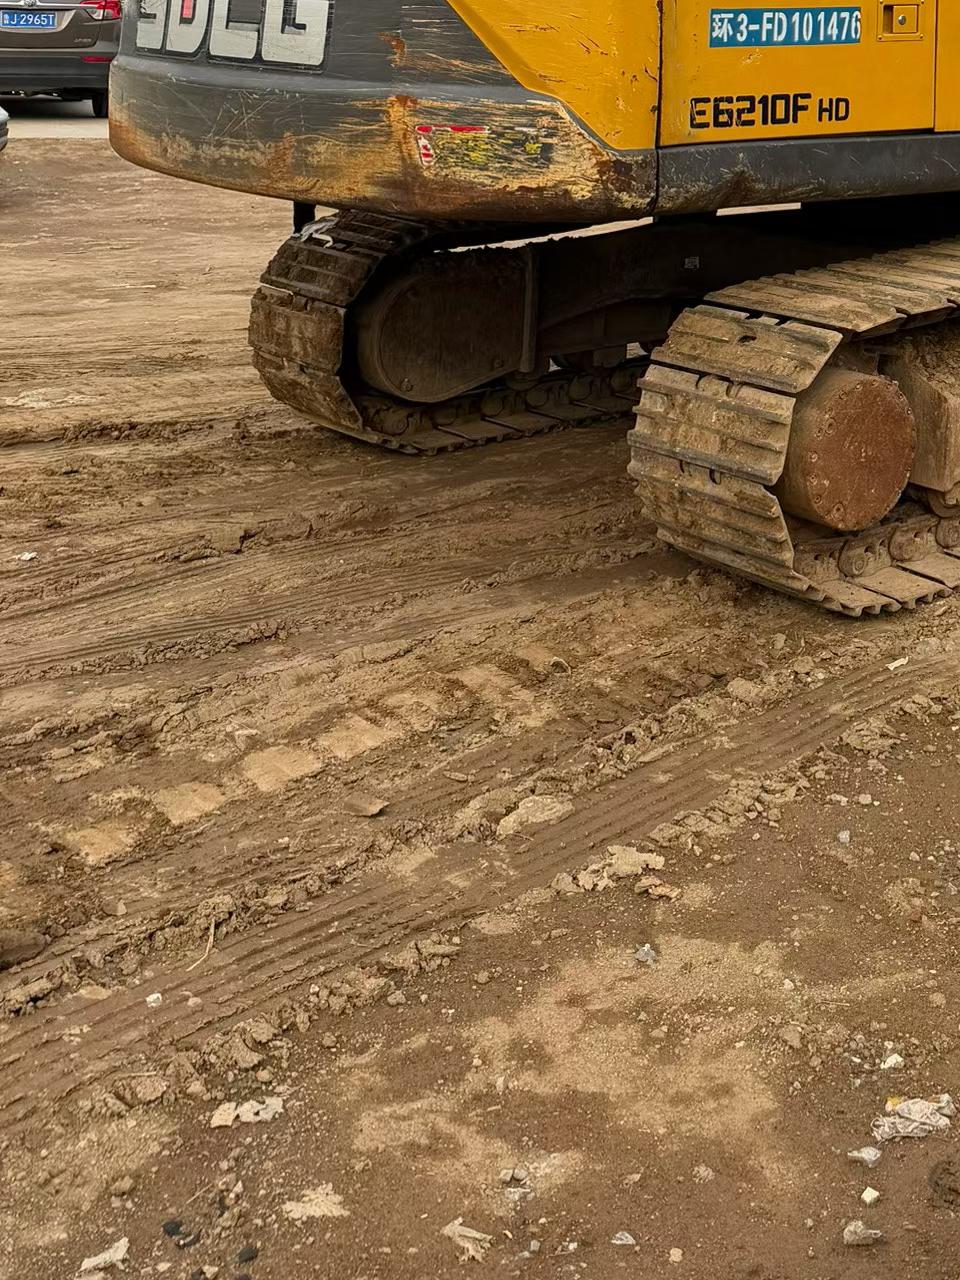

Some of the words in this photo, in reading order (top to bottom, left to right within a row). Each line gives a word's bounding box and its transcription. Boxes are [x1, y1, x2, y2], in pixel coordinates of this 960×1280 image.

[711, 10, 861, 43] 环3-FD101476
[690, 93, 812, 129] E6210F
[818, 97, 849, 122] HD
